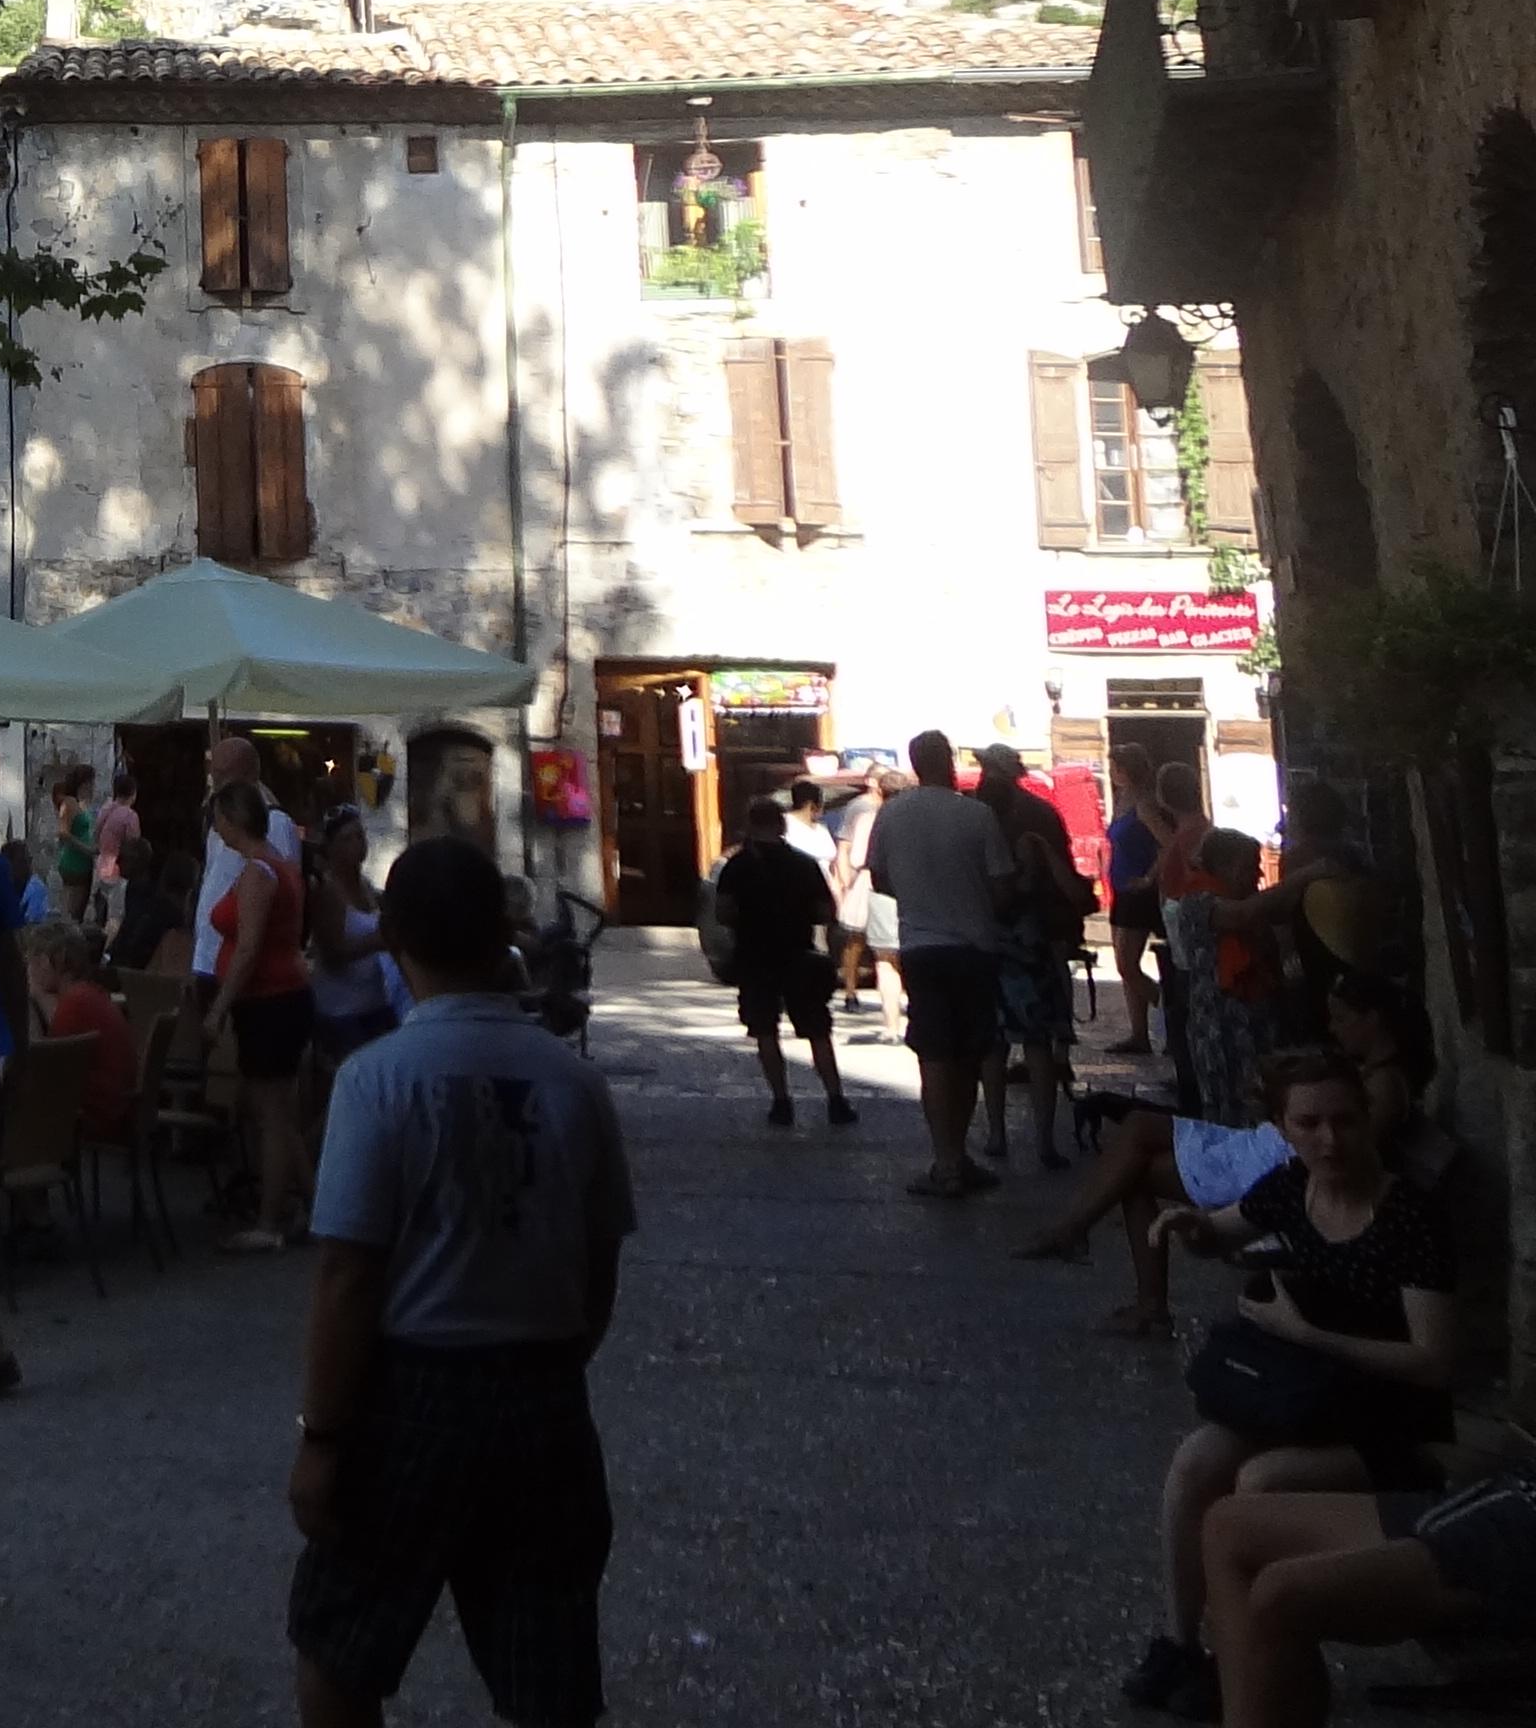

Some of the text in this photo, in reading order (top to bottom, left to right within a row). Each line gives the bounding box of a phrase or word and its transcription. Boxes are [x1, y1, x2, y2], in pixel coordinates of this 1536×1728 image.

[1047, 593, 1080, 616] Le
[1158, 630, 1188, 647] BAR
[1190, 626, 1253, 647] GLACIER
